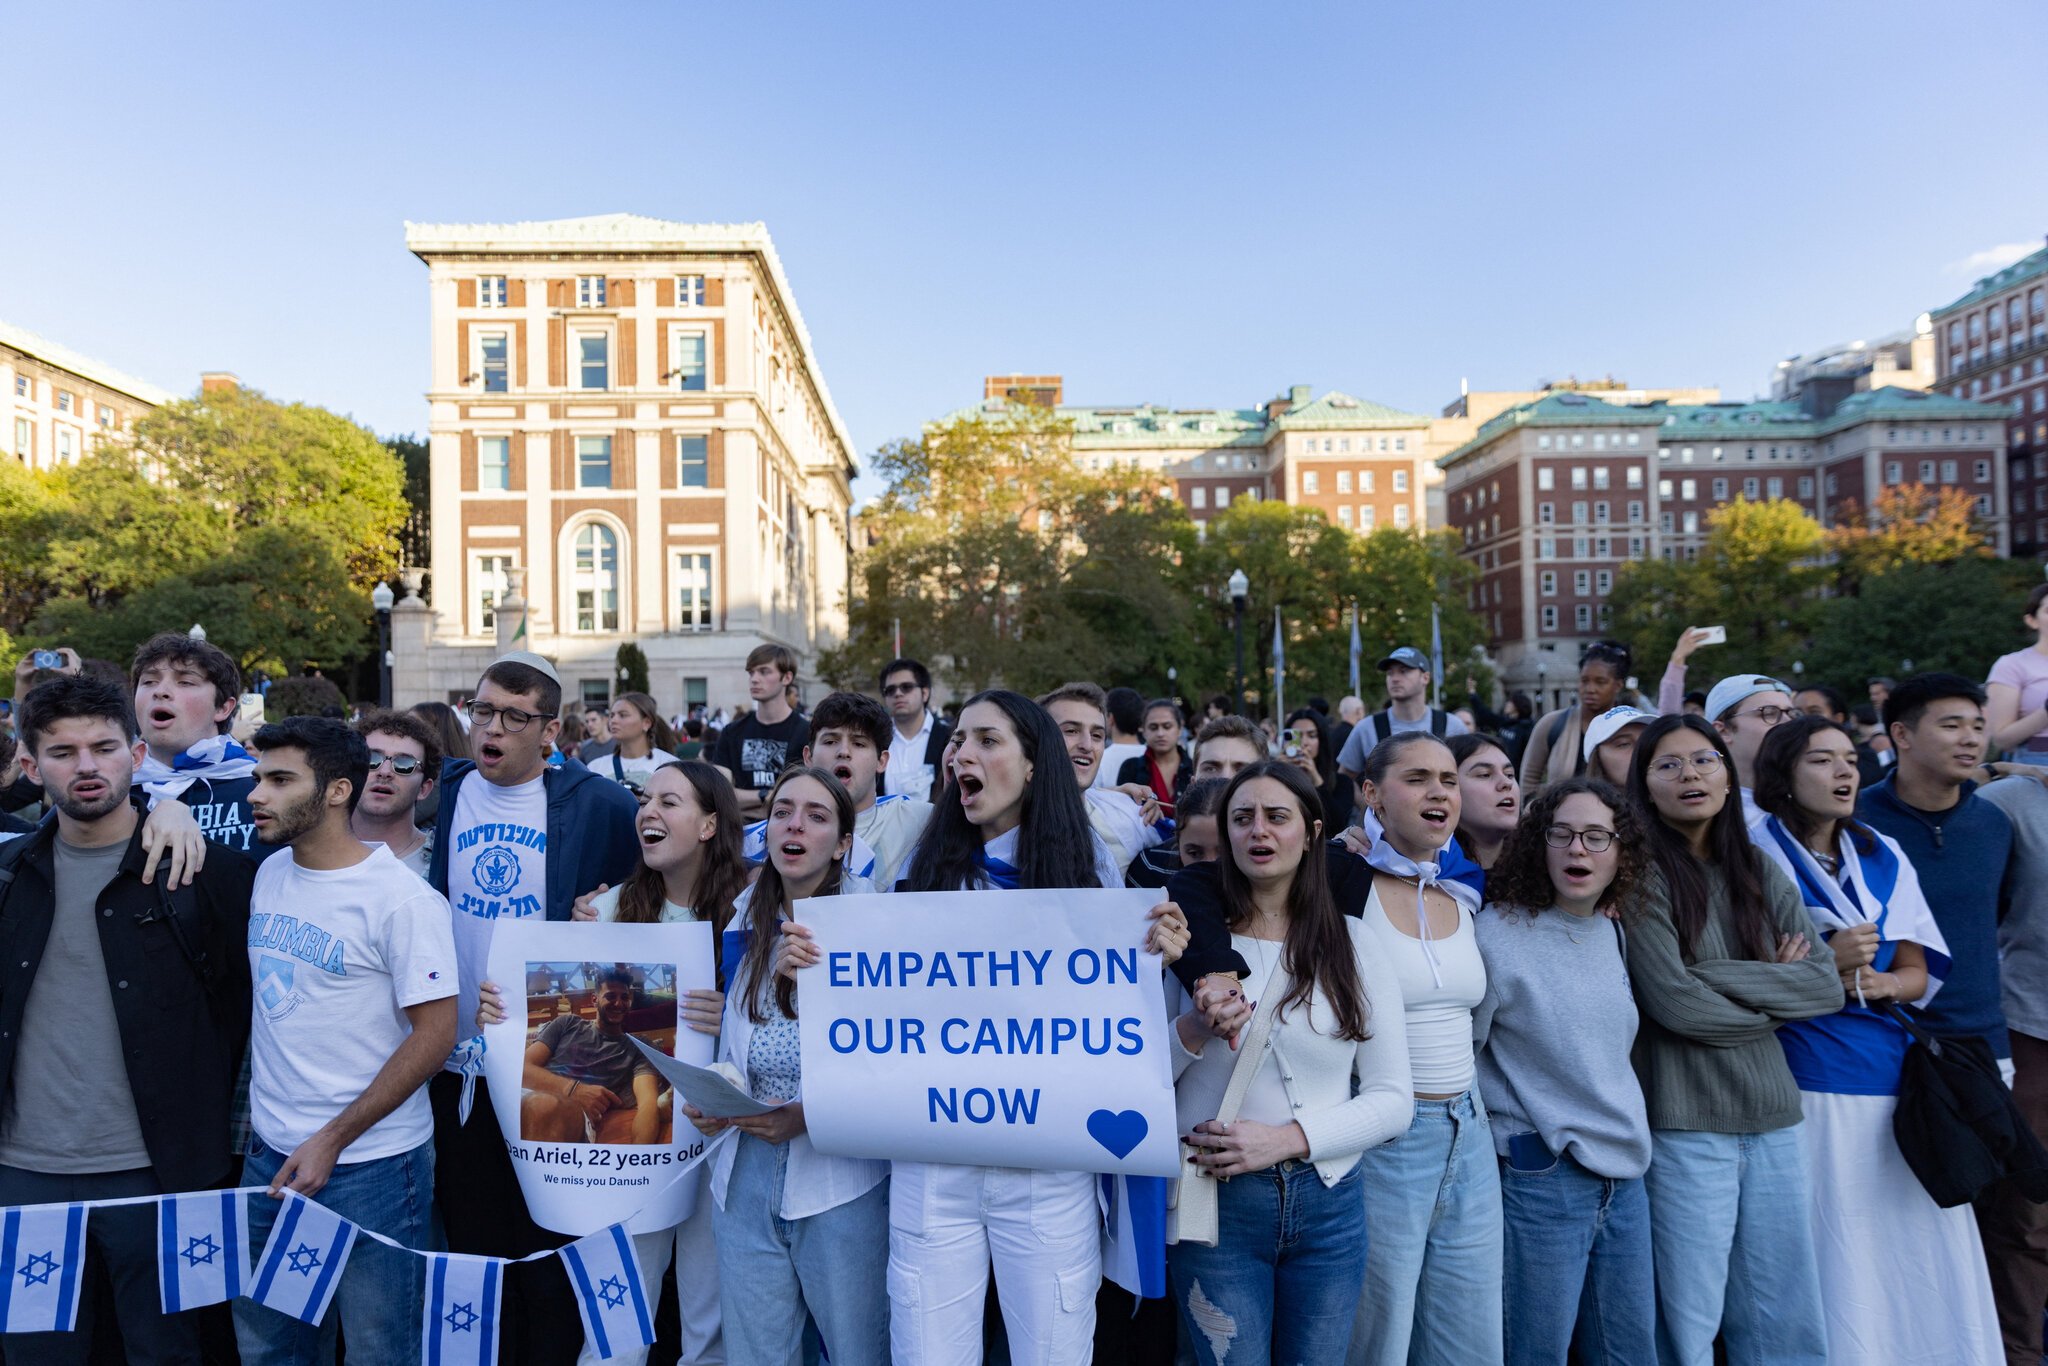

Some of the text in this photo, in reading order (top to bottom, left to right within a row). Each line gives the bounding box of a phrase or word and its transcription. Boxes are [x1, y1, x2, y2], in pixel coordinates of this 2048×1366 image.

[190, 801, 241, 830] BIA
[457, 823, 547, 854] אוניברסיטת
[829, 947, 1138, 987] EMPATHY ON
[828, 1017, 1144, 1056] OUR CAMPUS
[927, 1087, 1041, 1125] NOW
[533, 1147, 583, 1169] Ariel,
[588, 1149, 611, 1166] 22
[615, 1152, 672, 1171] years
[677, 1139, 704, 1162] old
[543, 1174, 650, 1188] We miss you Danush
